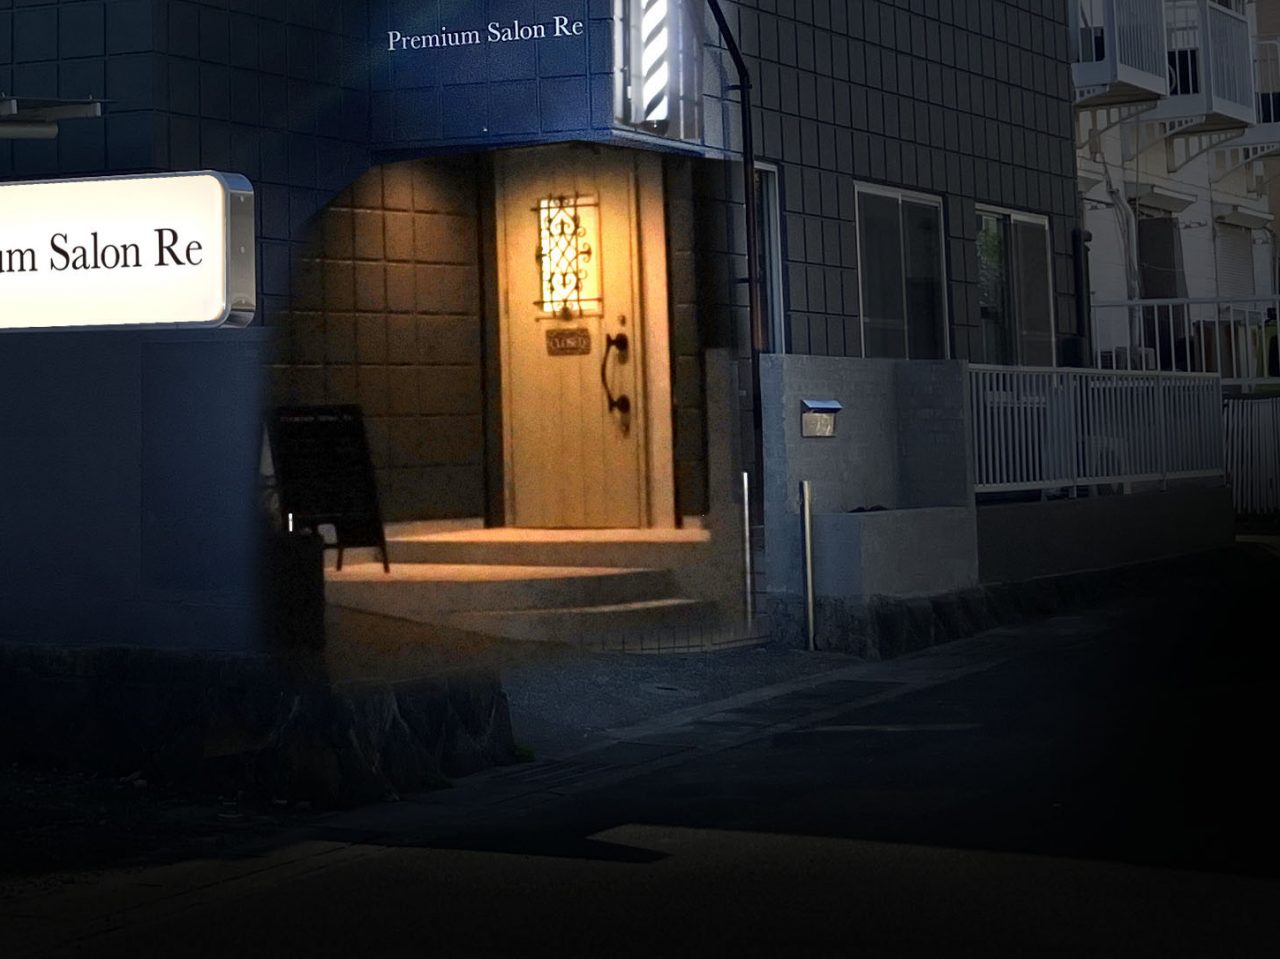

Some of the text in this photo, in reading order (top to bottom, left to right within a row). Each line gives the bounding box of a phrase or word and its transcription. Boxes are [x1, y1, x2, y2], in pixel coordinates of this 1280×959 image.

[387, 15, 584, 51] Premium Salon Re
[50, 231, 142, 271] Salon
[154, 226, 203, 267] Re
